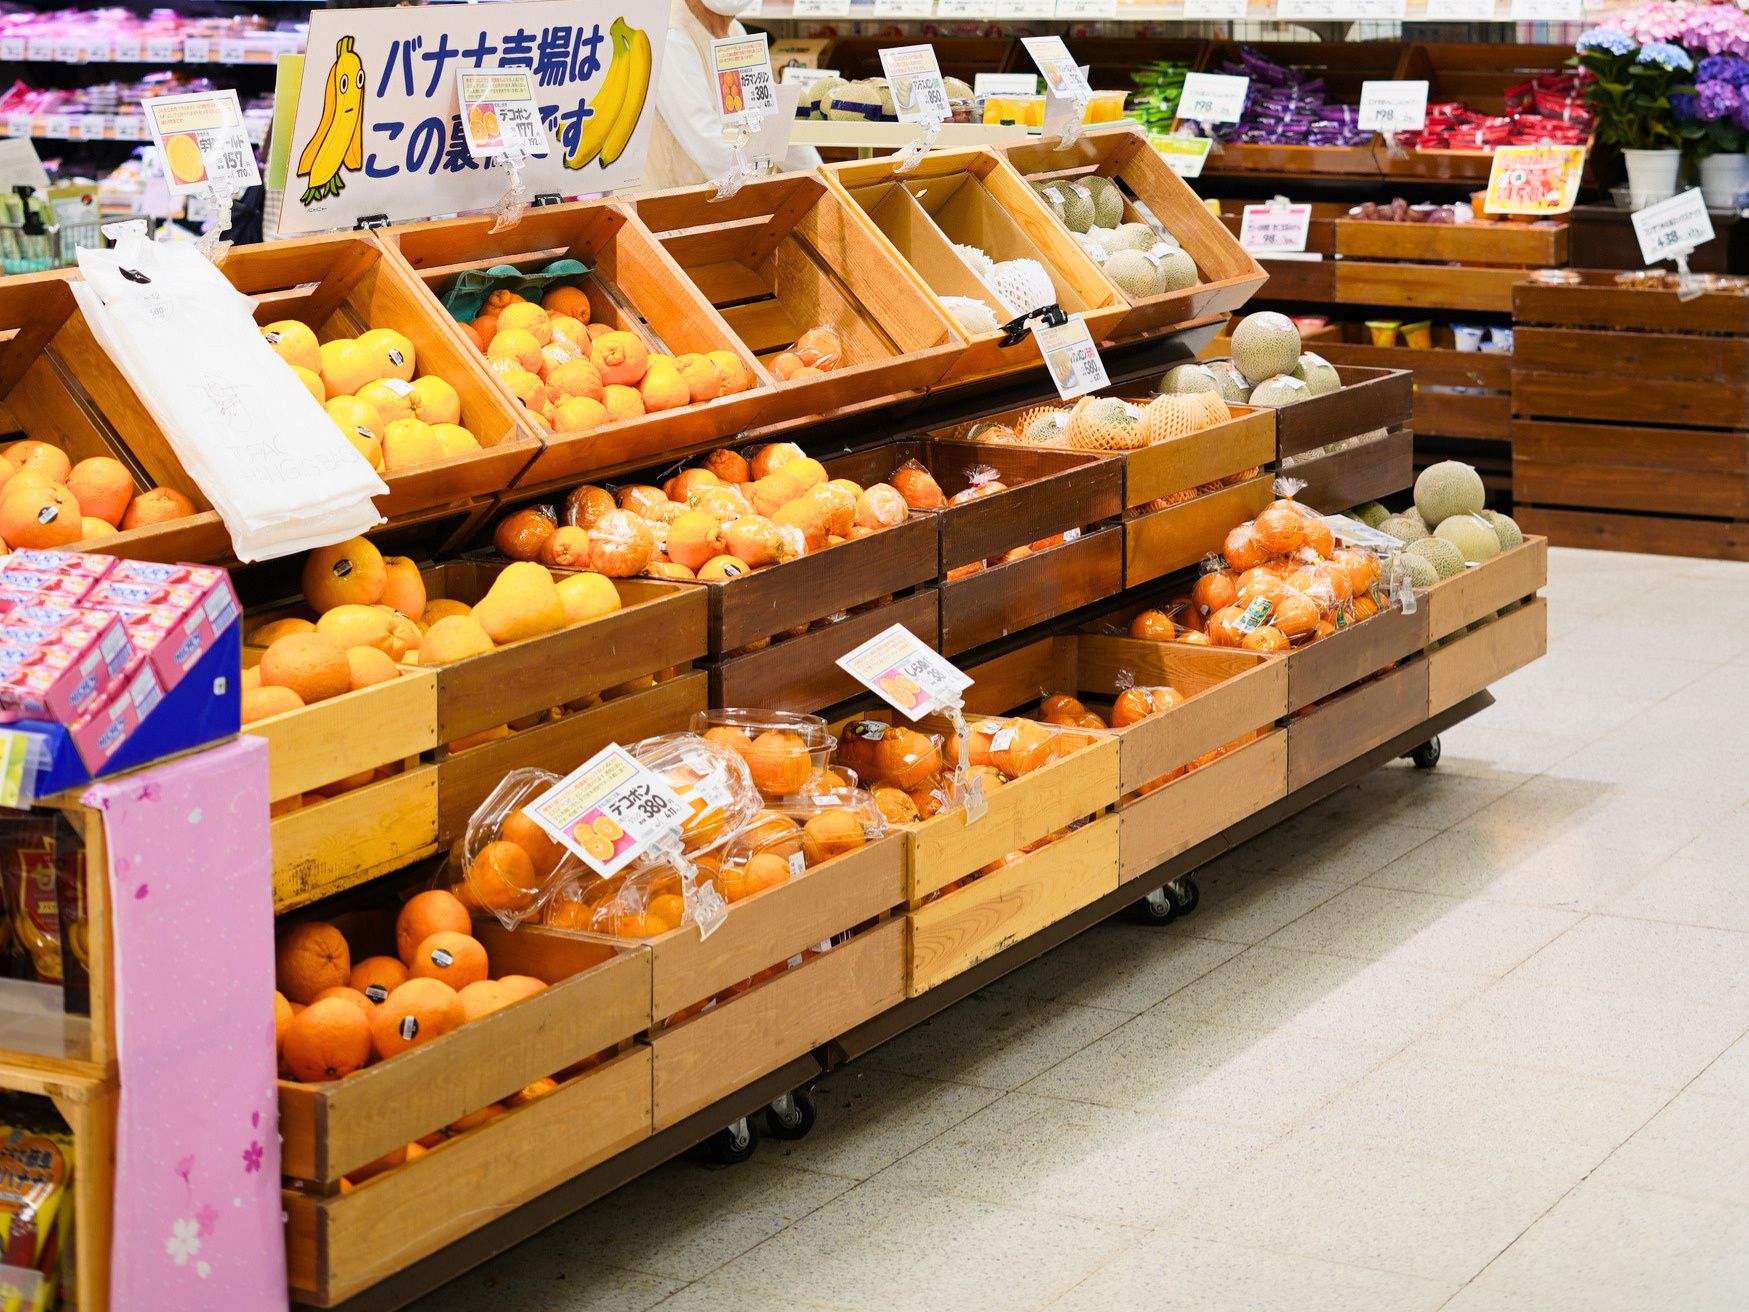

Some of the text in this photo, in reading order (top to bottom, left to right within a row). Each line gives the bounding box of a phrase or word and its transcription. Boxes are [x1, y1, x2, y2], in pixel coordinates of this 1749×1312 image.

[376, 23, 605, 98] バナナ売場は
[754, 85, 769, 101] 380
[928, 89, 942, 104] 850
[1194, 100, 1213, 112] 198
[1375, 109, 1394, 121] 198
[516, 122, 534, 137] 177
[364, 97, 594, 179] この裏です
[222, 151, 243, 169] 157
[1083, 359, 1098, 375] 580
[638, 794, 668, 818] 380
[664, 807, 677, 818] 411
